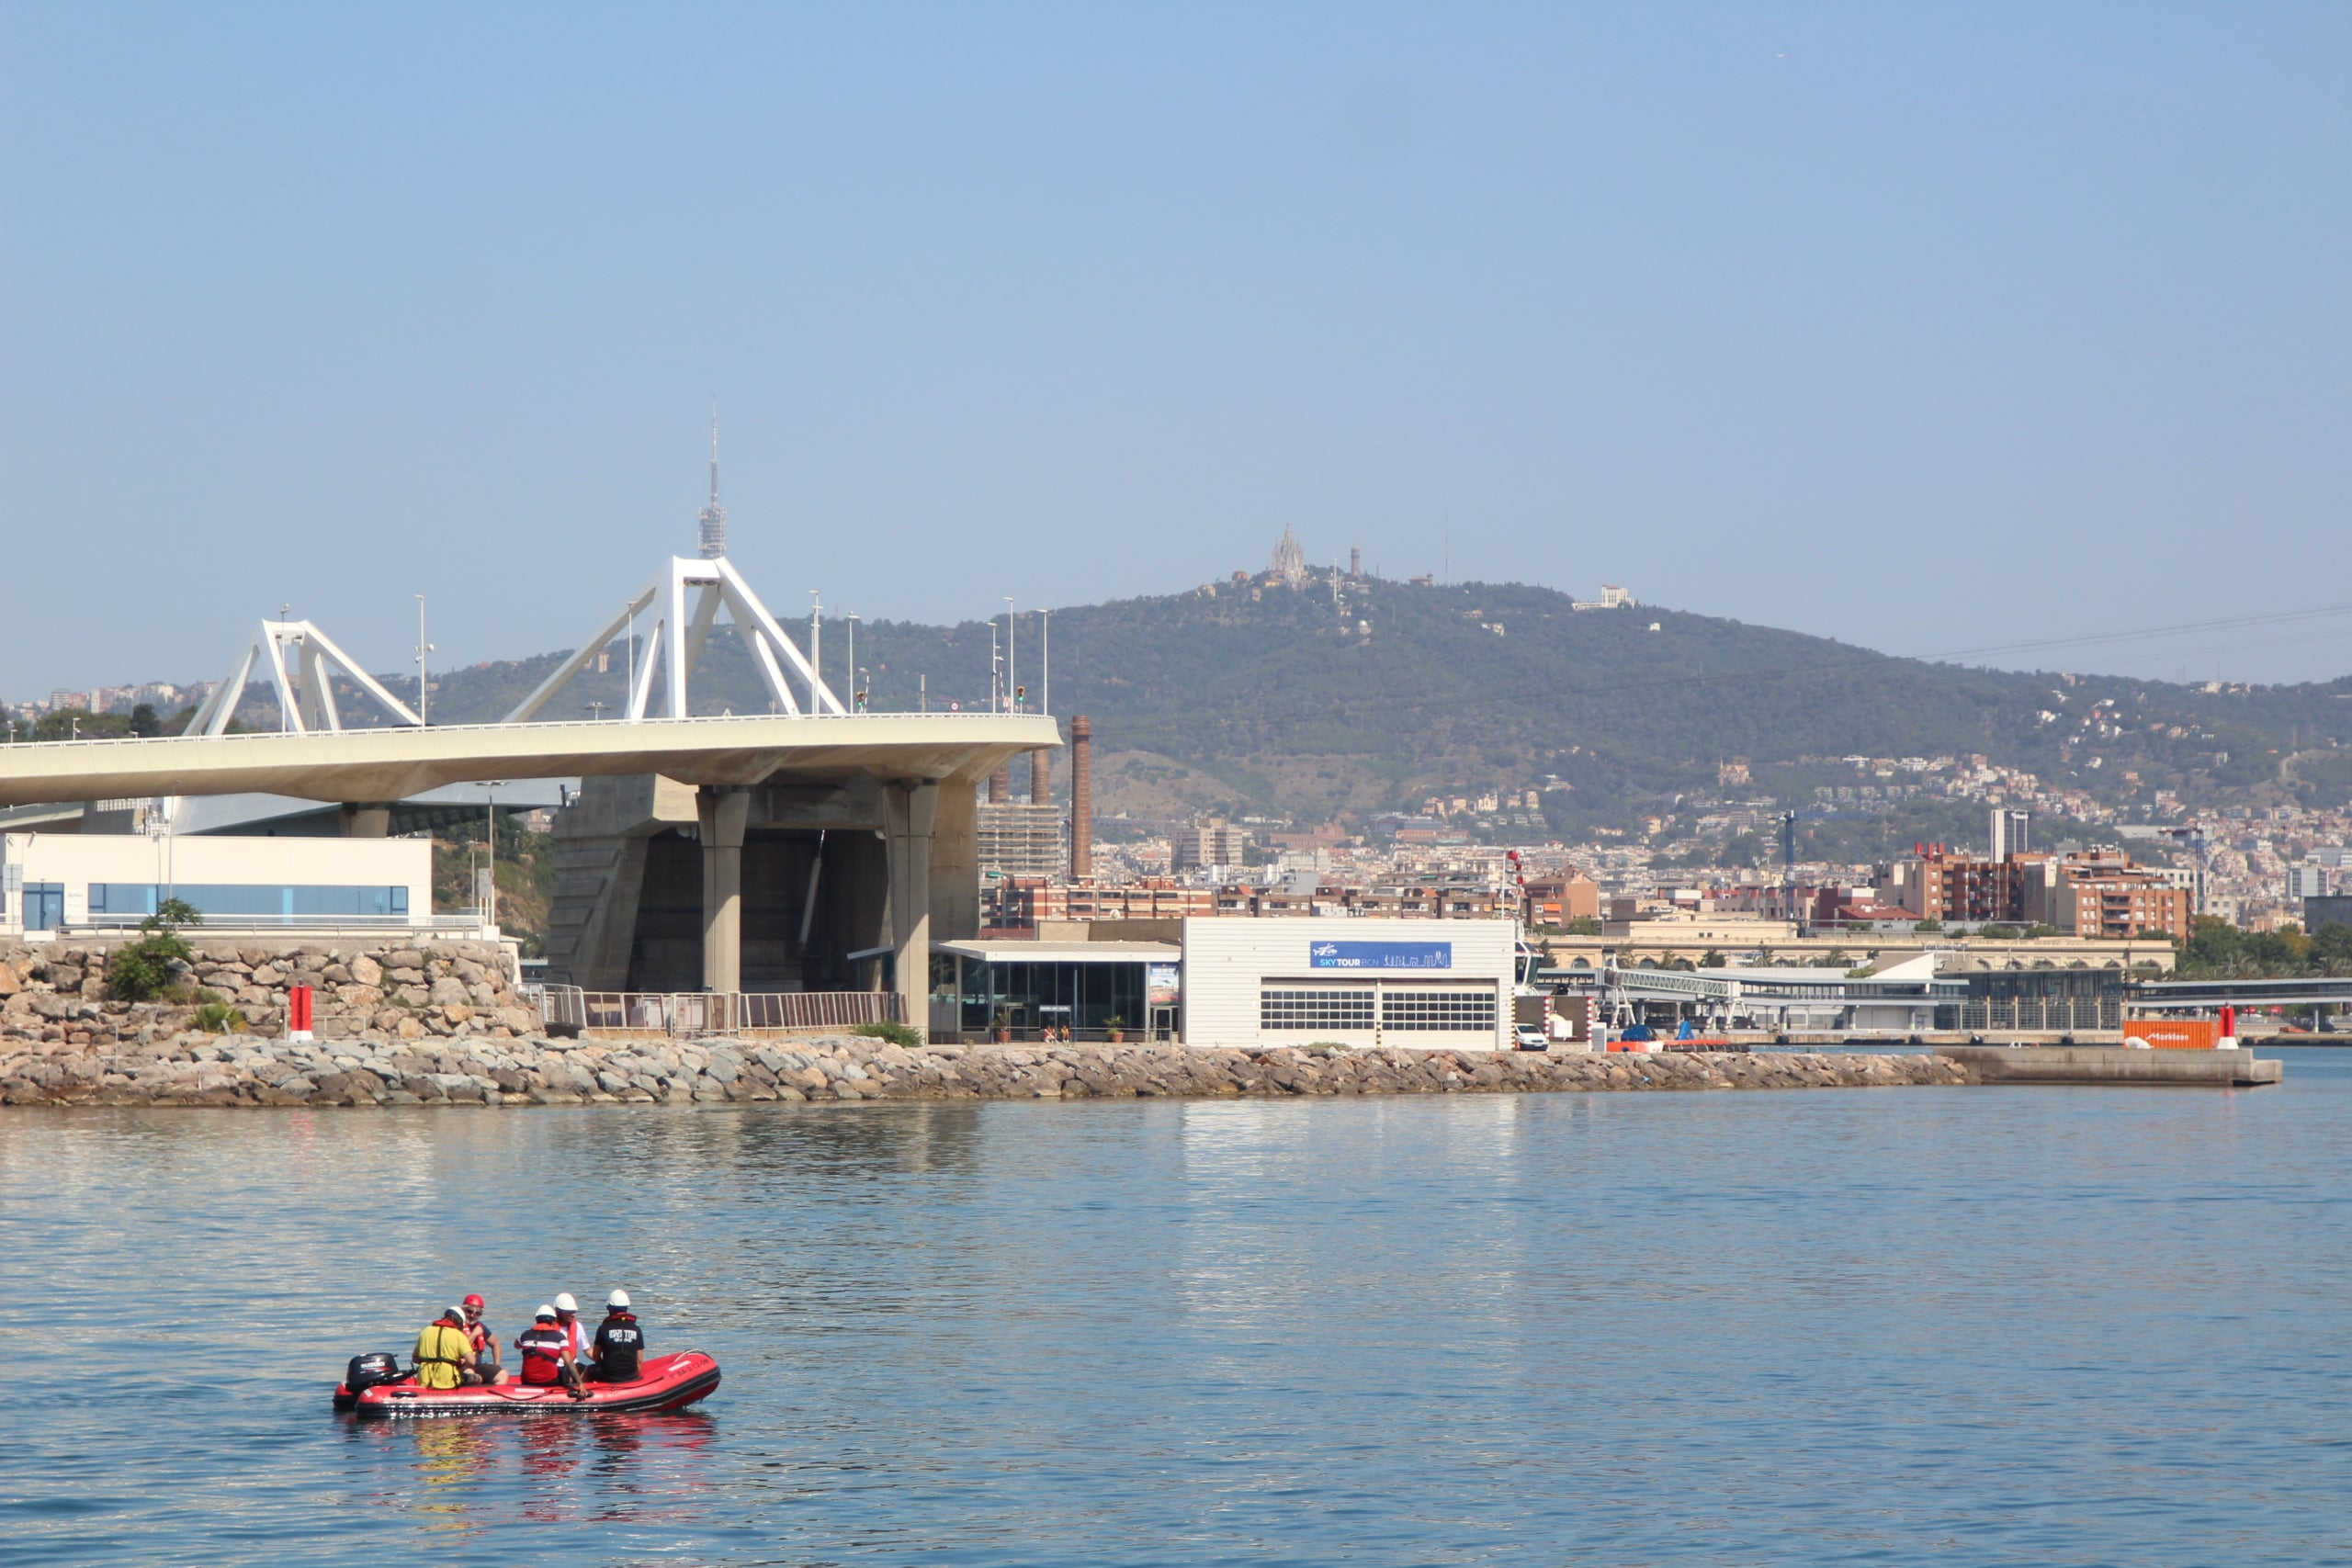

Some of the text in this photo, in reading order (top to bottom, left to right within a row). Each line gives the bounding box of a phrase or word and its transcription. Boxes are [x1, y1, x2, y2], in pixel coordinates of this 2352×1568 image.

[1319, 958, 1379, 967] SKY TOUR BCN
